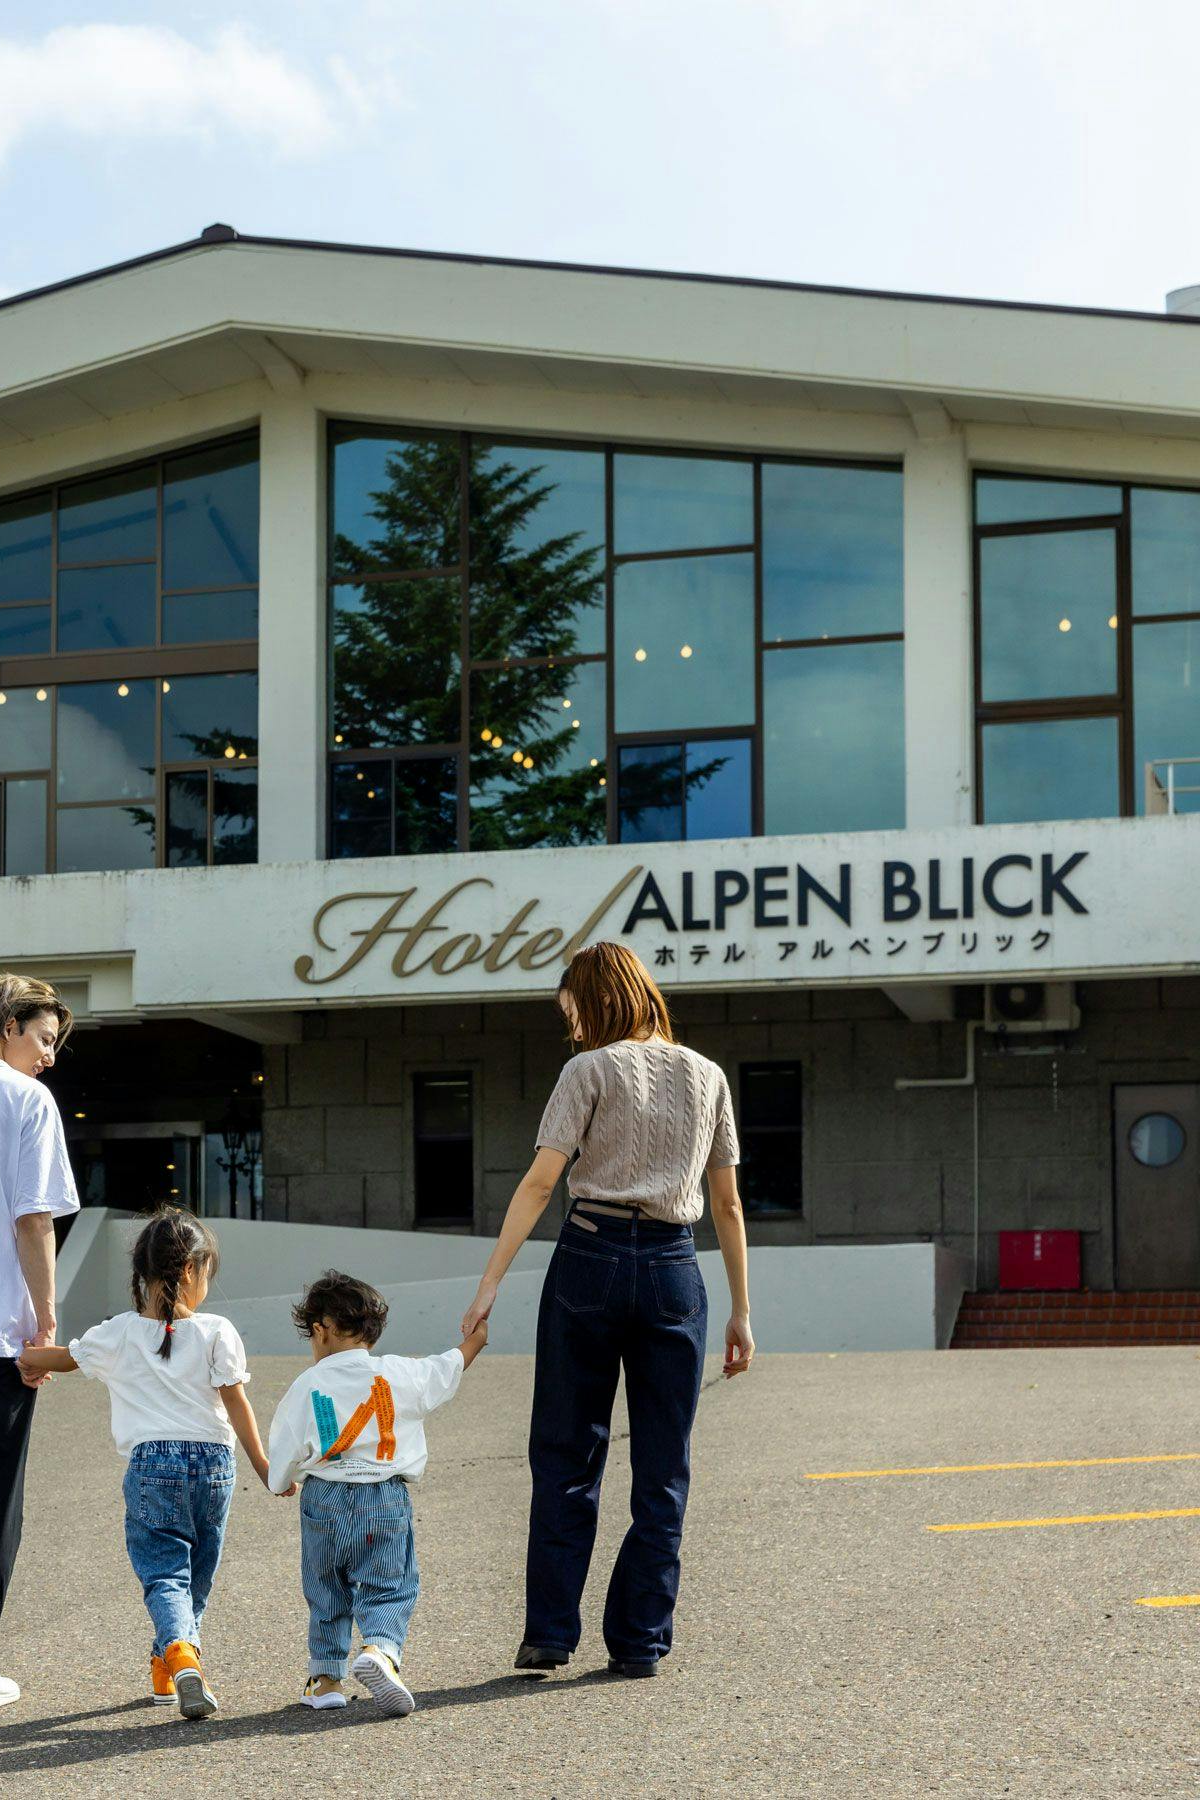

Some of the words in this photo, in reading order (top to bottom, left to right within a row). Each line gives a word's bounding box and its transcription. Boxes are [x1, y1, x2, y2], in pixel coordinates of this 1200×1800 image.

[294, 864, 644, 985] Hotel
[621, 862, 852, 935] ALPEN
[883, 851, 1090, 922] BLICK
[654, 943, 746, 966] ホテル
